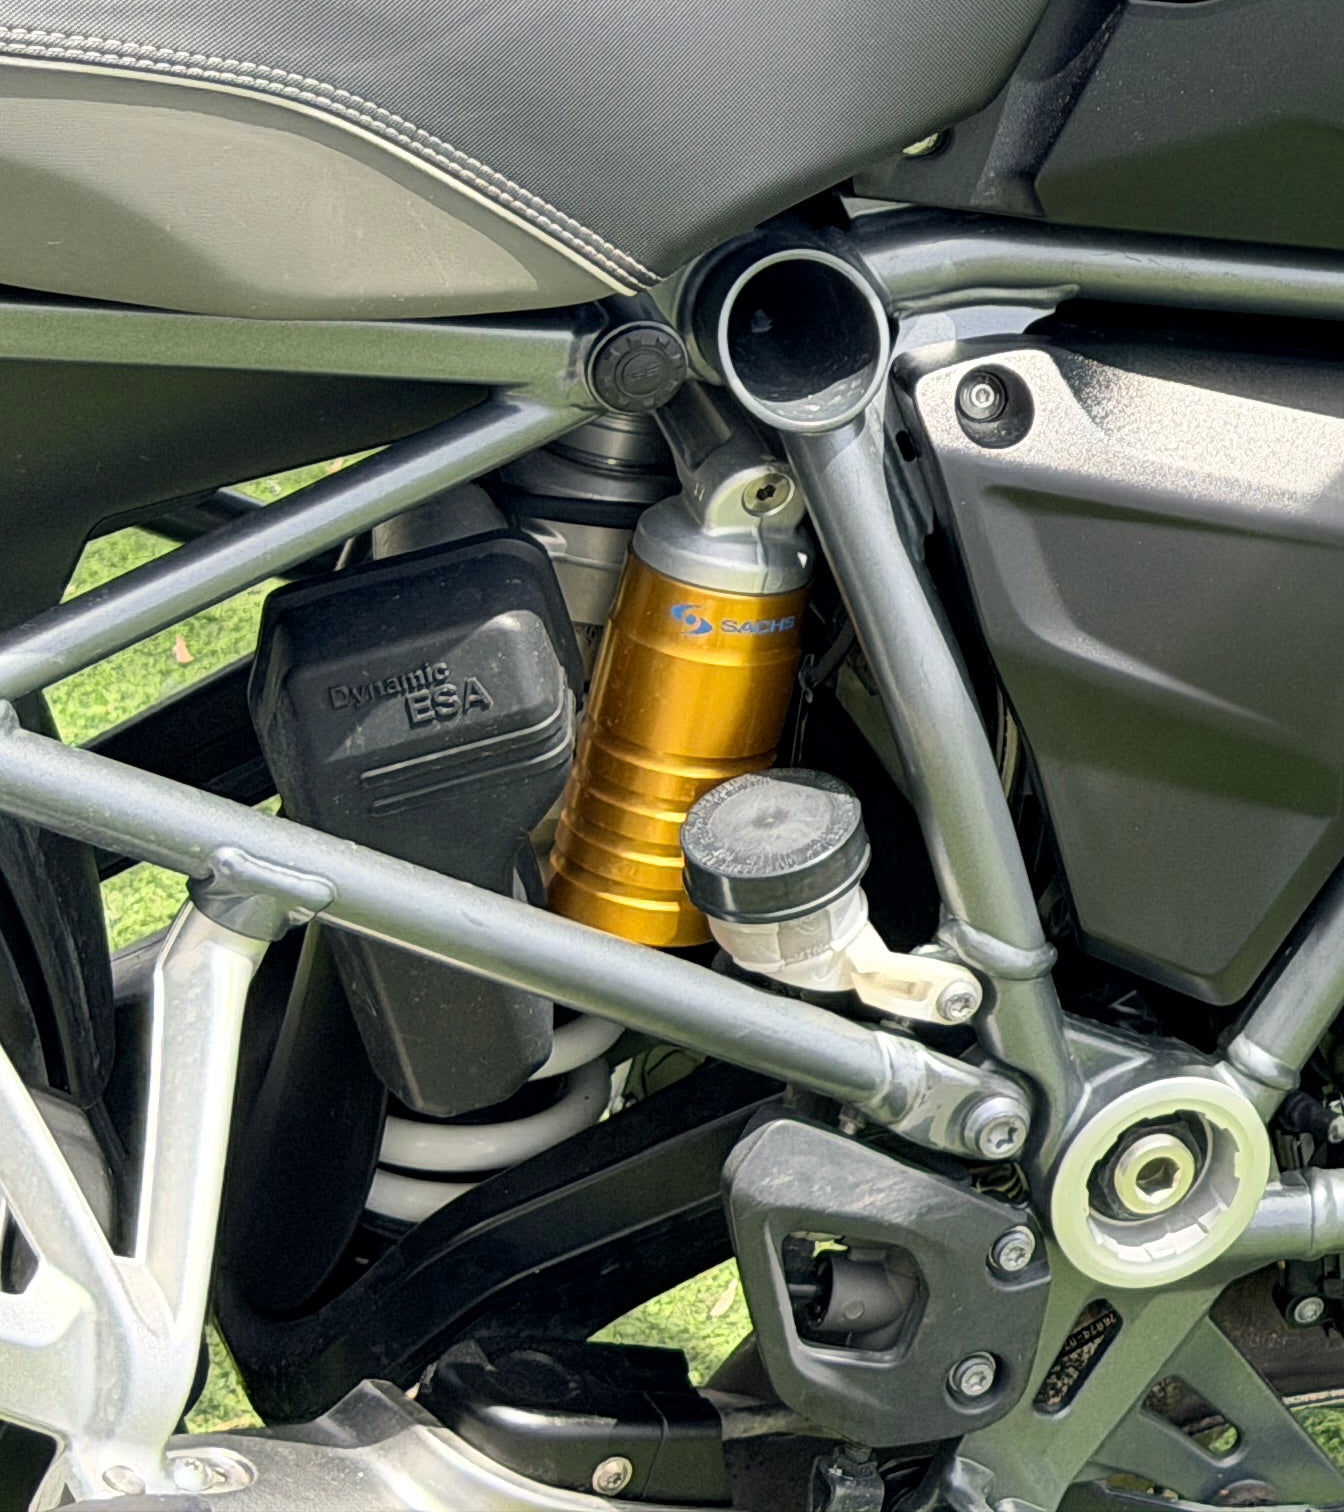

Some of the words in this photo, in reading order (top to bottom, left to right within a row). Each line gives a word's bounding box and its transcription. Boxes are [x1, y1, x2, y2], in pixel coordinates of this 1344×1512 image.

[720, 615, 796, 634] SACHS
[329, 661, 450, 710] Dynamic
[405, 676, 494, 728] ESA
